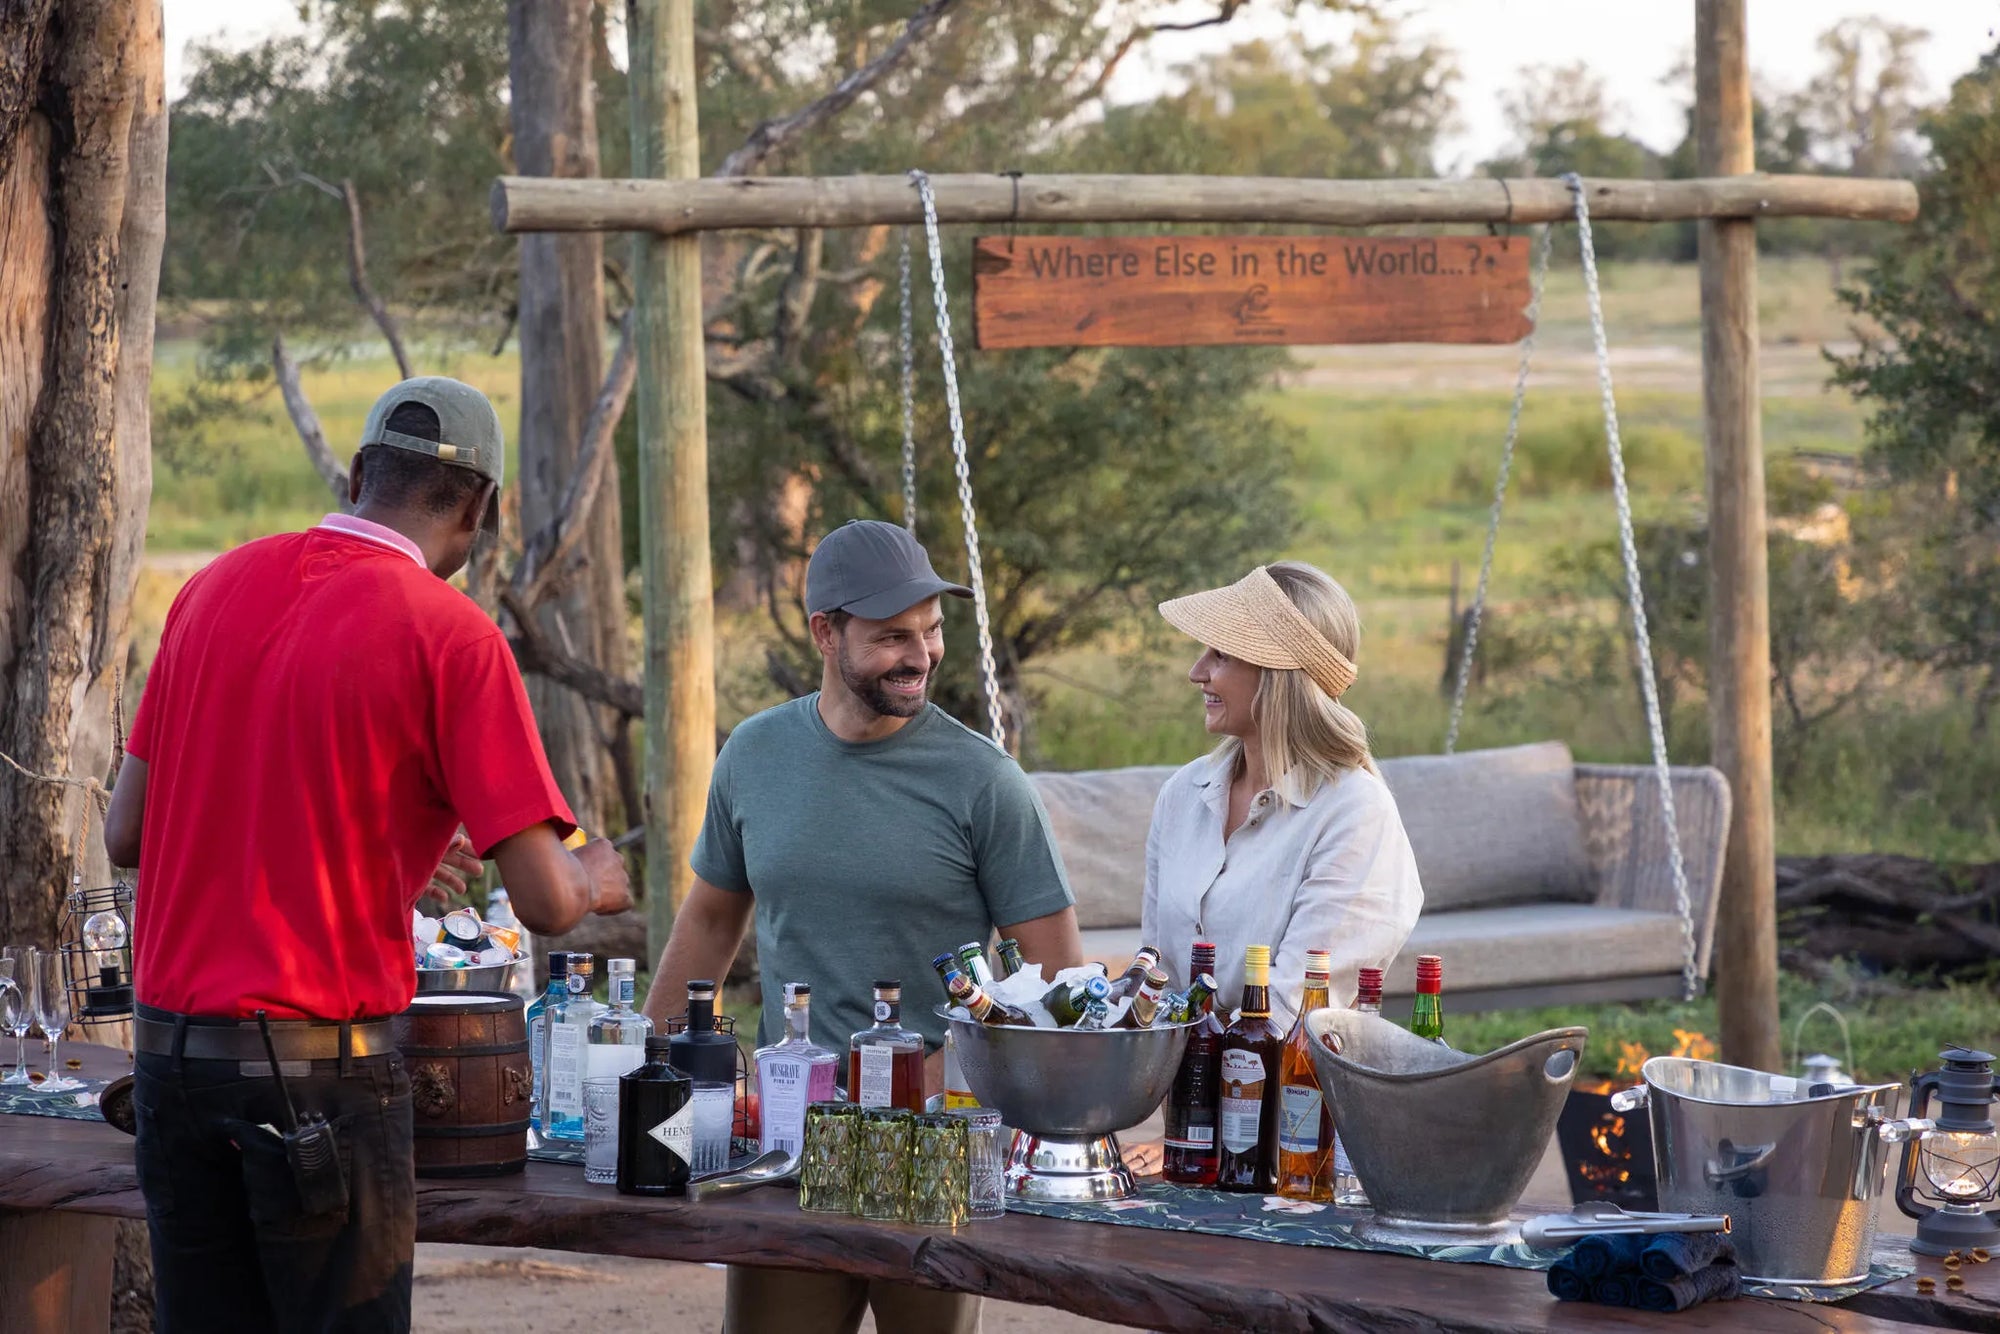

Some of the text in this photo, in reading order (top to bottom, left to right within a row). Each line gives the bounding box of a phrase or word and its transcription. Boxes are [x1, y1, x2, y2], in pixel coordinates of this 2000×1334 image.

[1028, 245, 1139, 278] Where
[1154, 244, 1216, 277] Else
[1231, 246, 1258, 277] in
[1276, 244, 1327, 276] the
